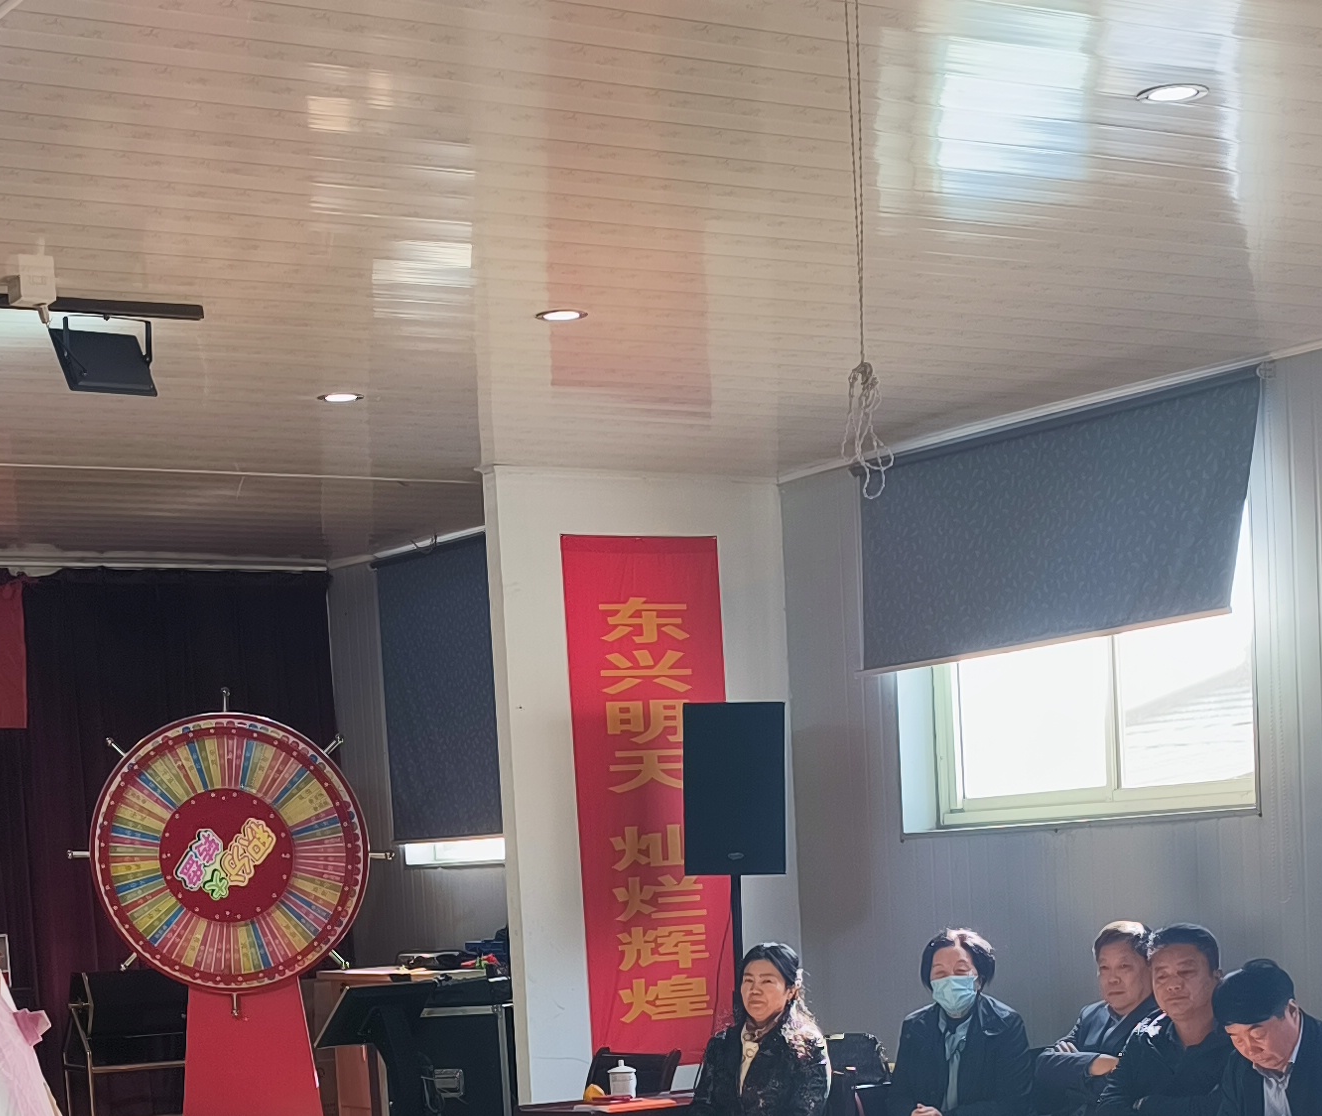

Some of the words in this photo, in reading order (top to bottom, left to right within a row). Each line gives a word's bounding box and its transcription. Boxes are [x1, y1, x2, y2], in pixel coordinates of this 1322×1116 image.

[598, 597, 693, 794] 东兴明天
[609, 823, 714, 1023] 灿烂辉煌
